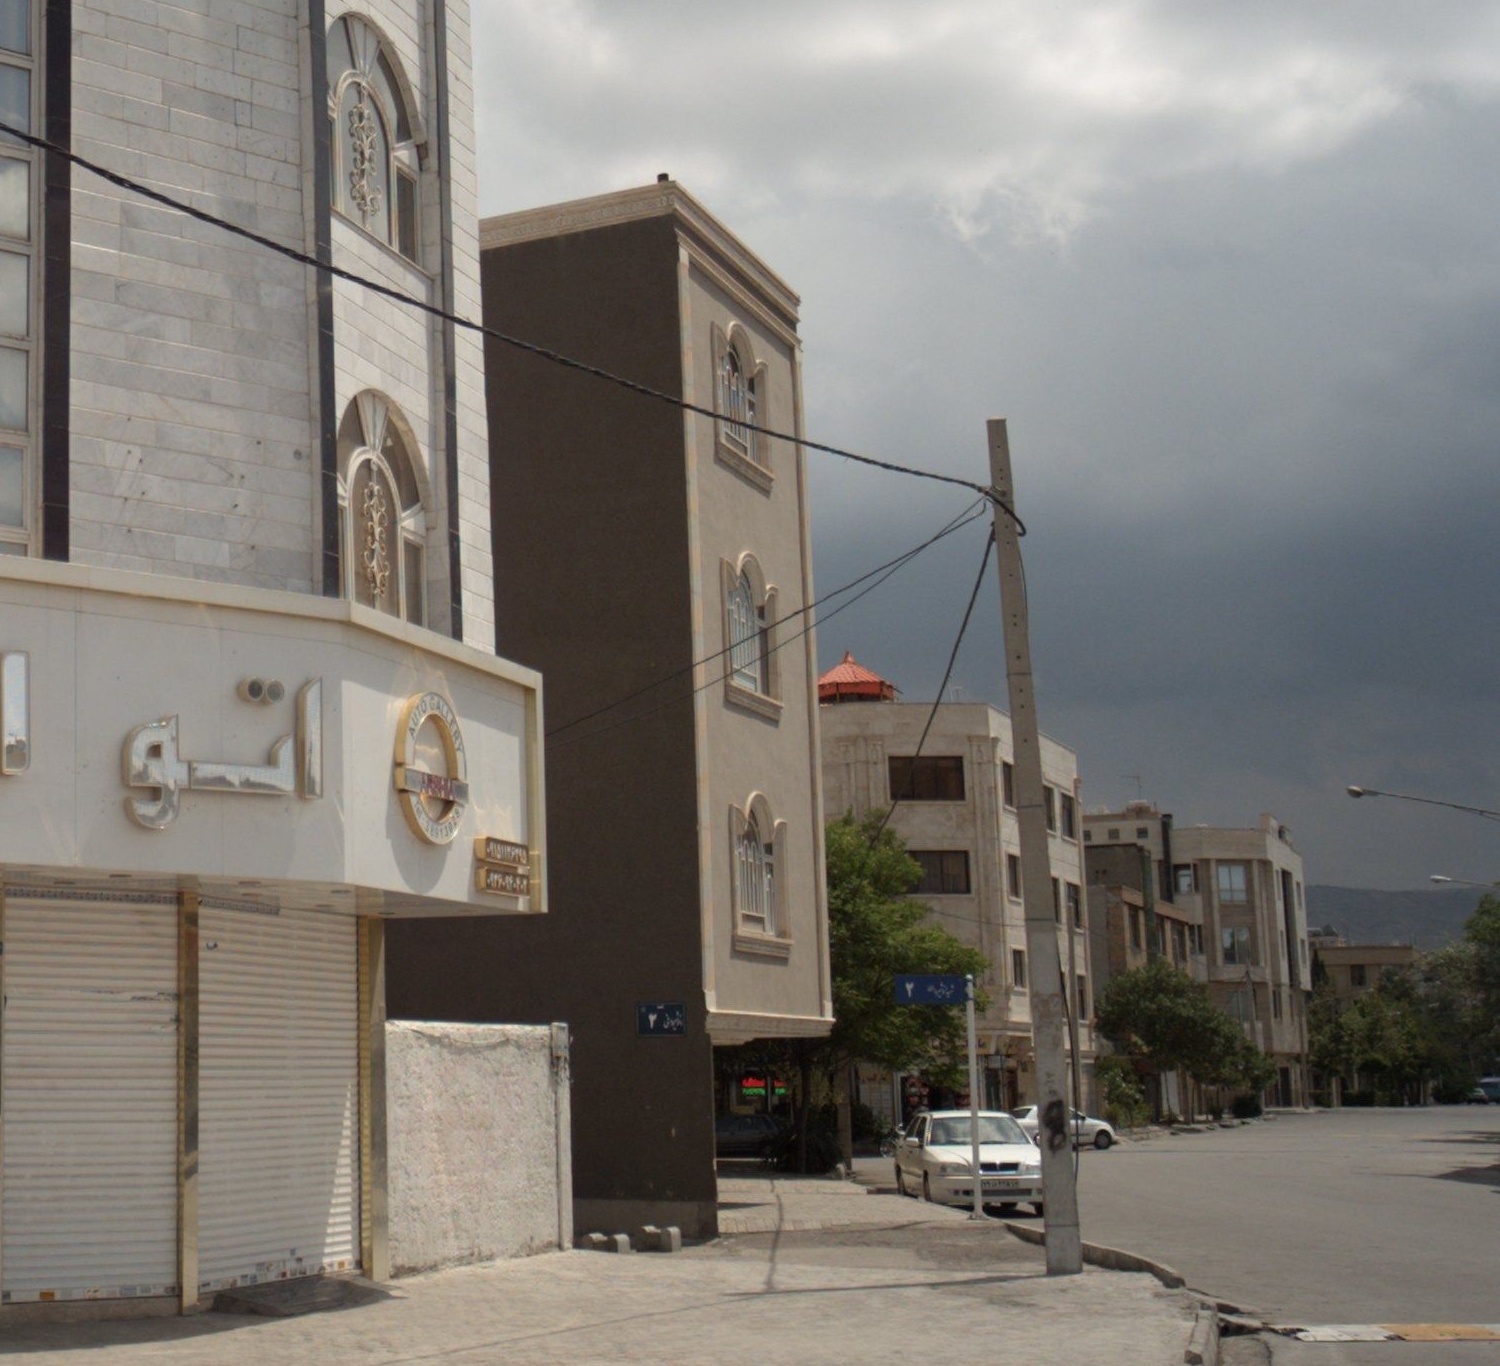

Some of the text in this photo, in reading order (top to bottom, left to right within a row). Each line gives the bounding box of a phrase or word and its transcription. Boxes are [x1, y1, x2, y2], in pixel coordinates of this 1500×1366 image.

[122, 677, 324, 830] اتو
[409, 695, 465, 753] AUTO GALLERY
